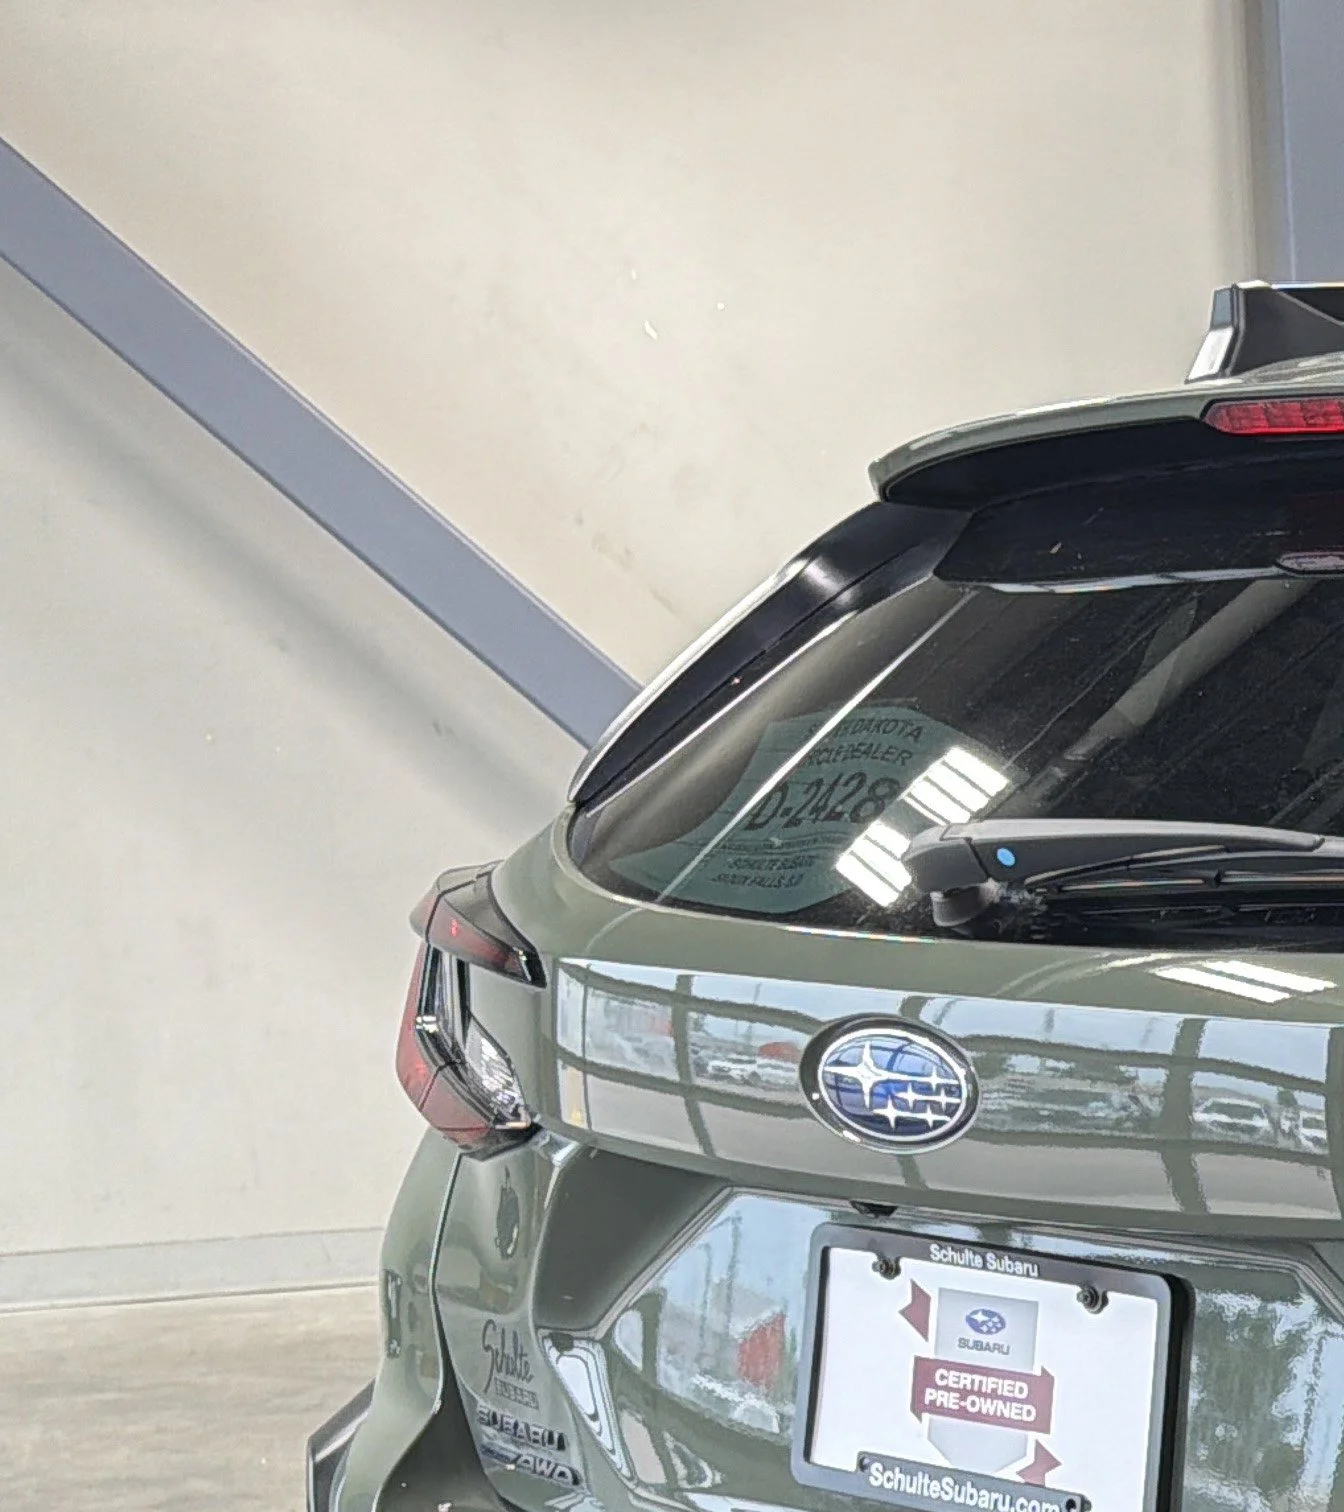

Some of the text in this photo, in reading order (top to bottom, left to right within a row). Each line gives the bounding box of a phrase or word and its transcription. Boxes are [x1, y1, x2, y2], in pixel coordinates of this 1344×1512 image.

[930, 1243, 1039, 1277] Schulte Subaru
[957, 1337, 1011, 1356] SUBARU
[934, 1368, 1029, 1399] CERTIFIED
[924, 1387, 1037, 1422] PRE-OWNED
